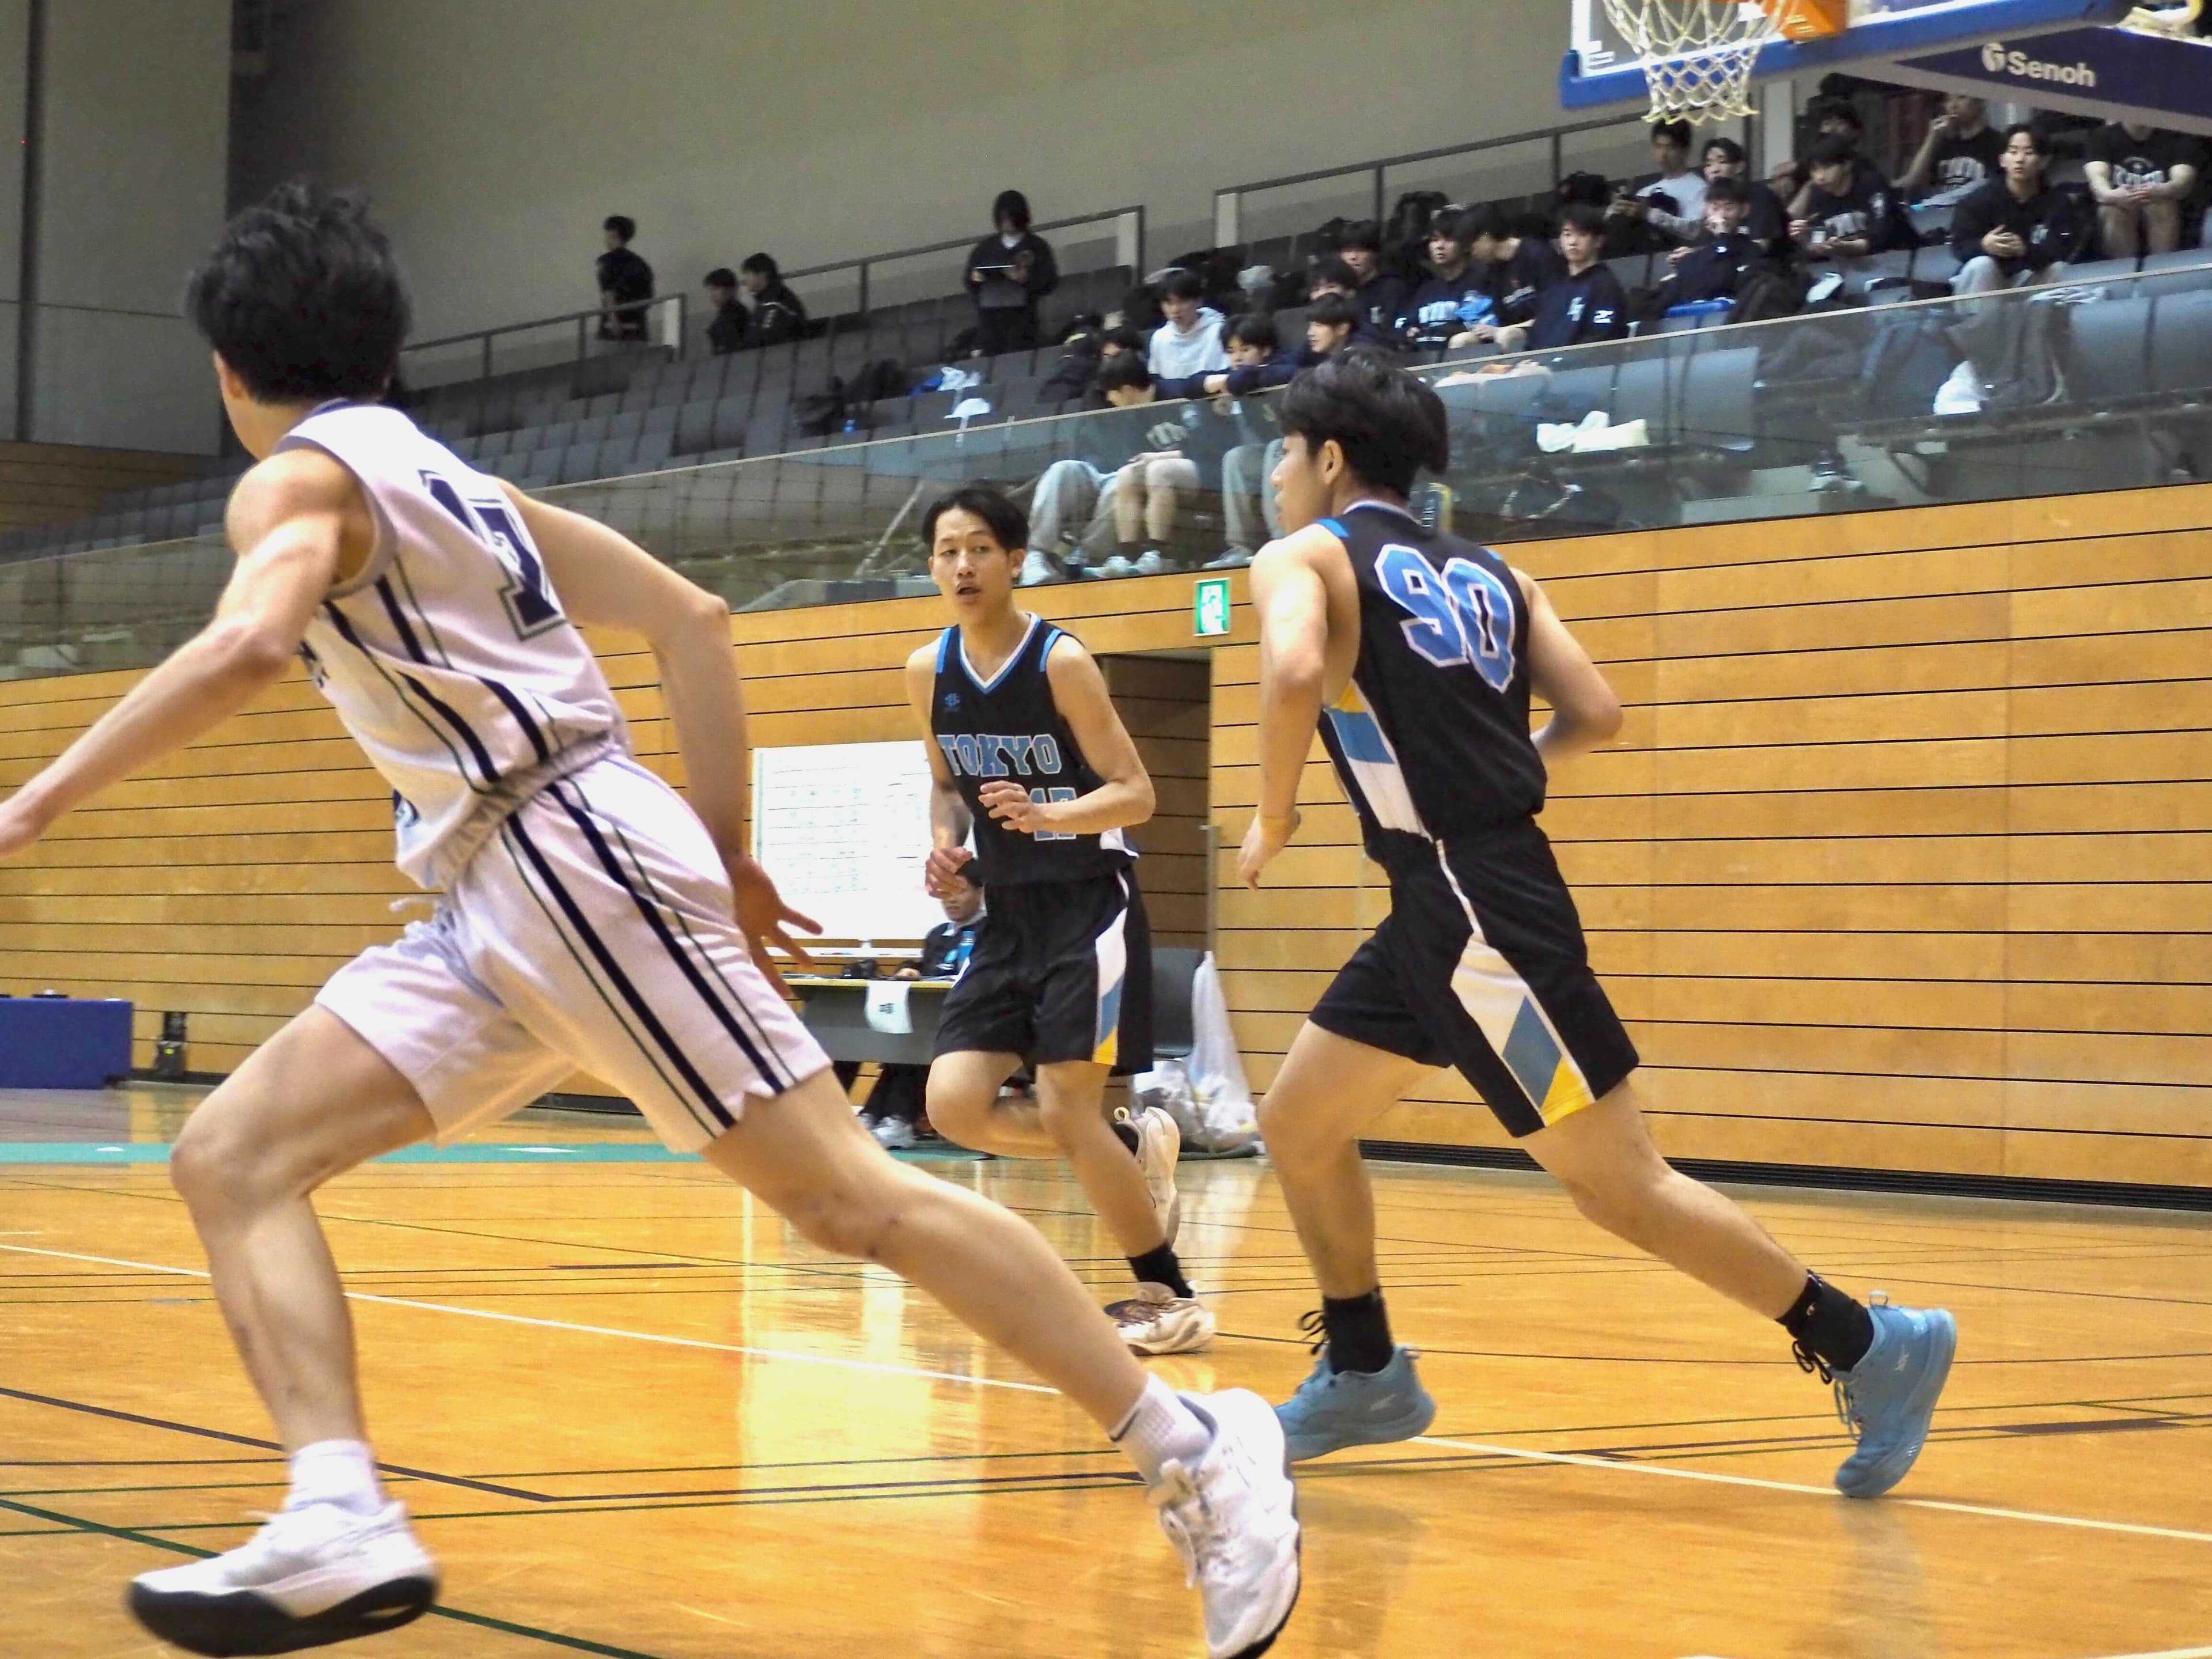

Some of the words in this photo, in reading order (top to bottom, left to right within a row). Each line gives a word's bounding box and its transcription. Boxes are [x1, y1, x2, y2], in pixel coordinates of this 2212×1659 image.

[2007, 51, 2097, 87] Senoh
[1374, 544, 1516, 694] 90
[936, 733, 1062, 778] TOKYO
